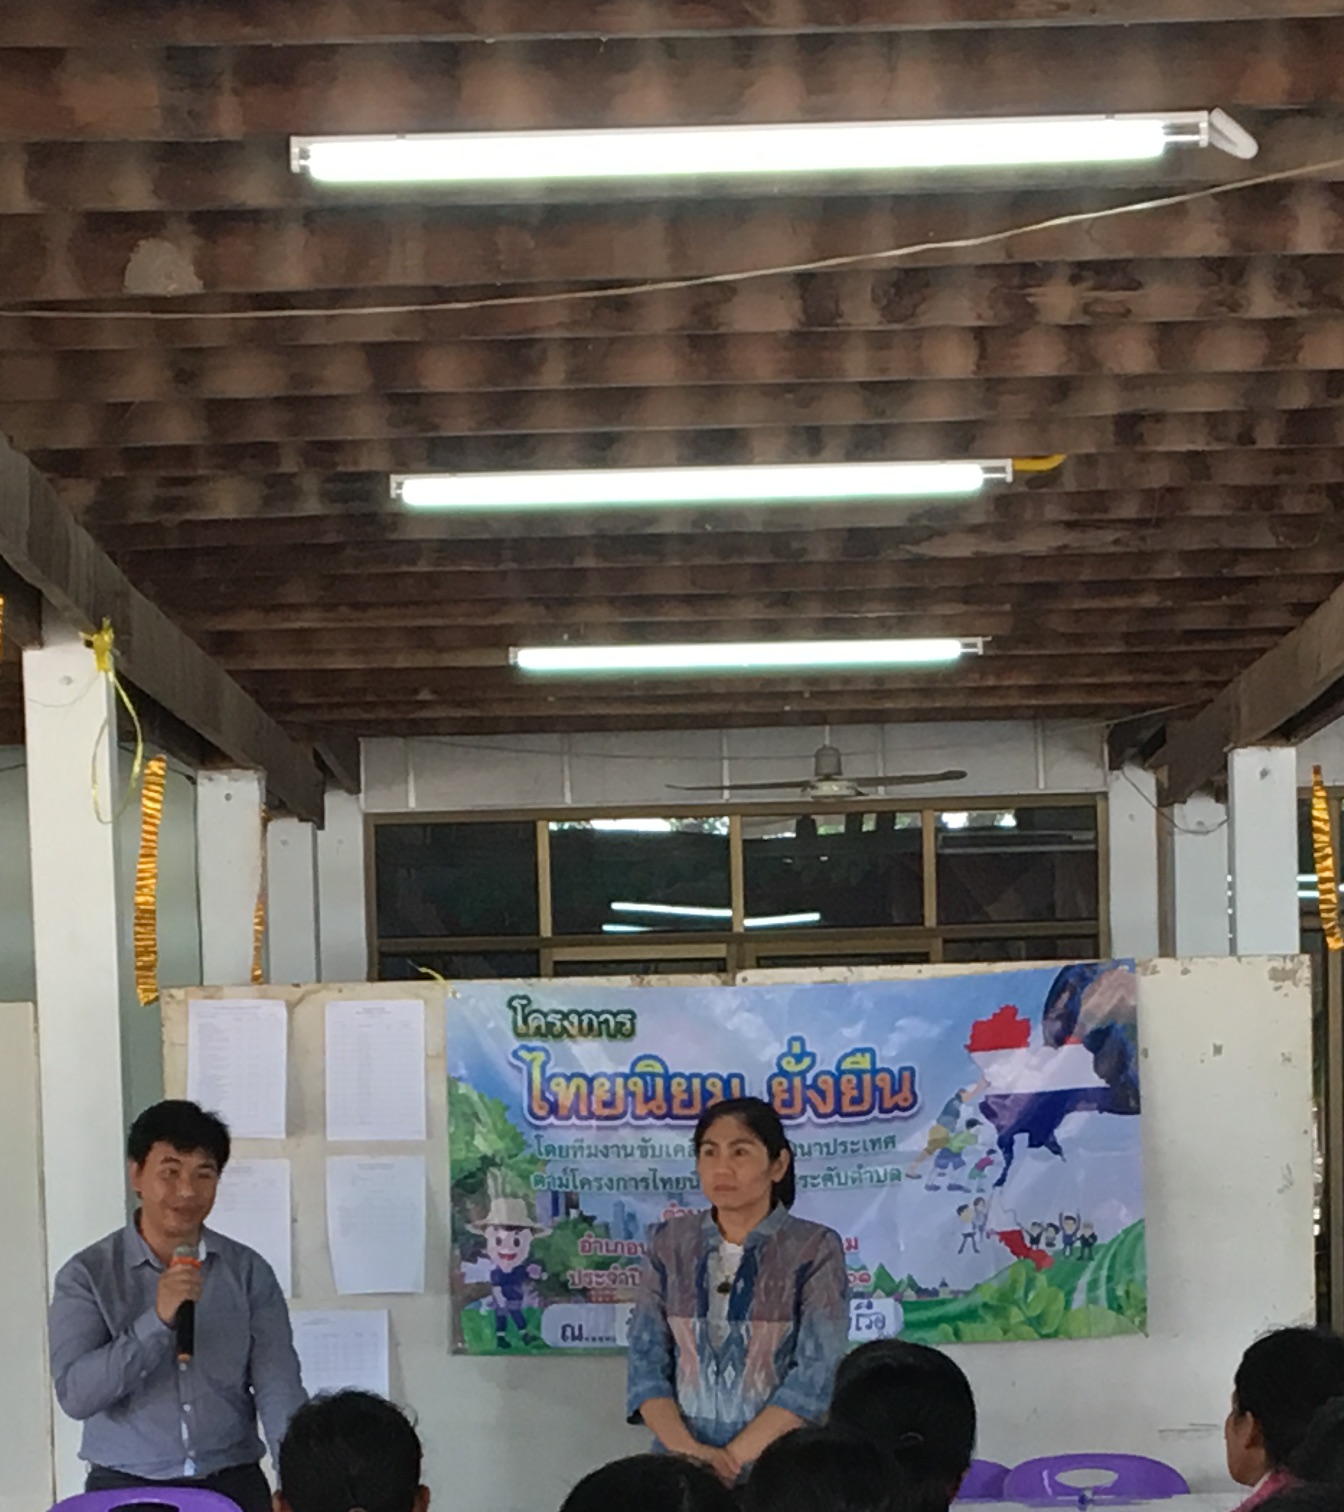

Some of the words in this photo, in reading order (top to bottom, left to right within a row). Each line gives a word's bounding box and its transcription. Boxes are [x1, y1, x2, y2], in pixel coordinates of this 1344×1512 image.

[508, 994, 638, 1039] โครงการ
[767, 1035, 919, 1120] ยั่งยืน
